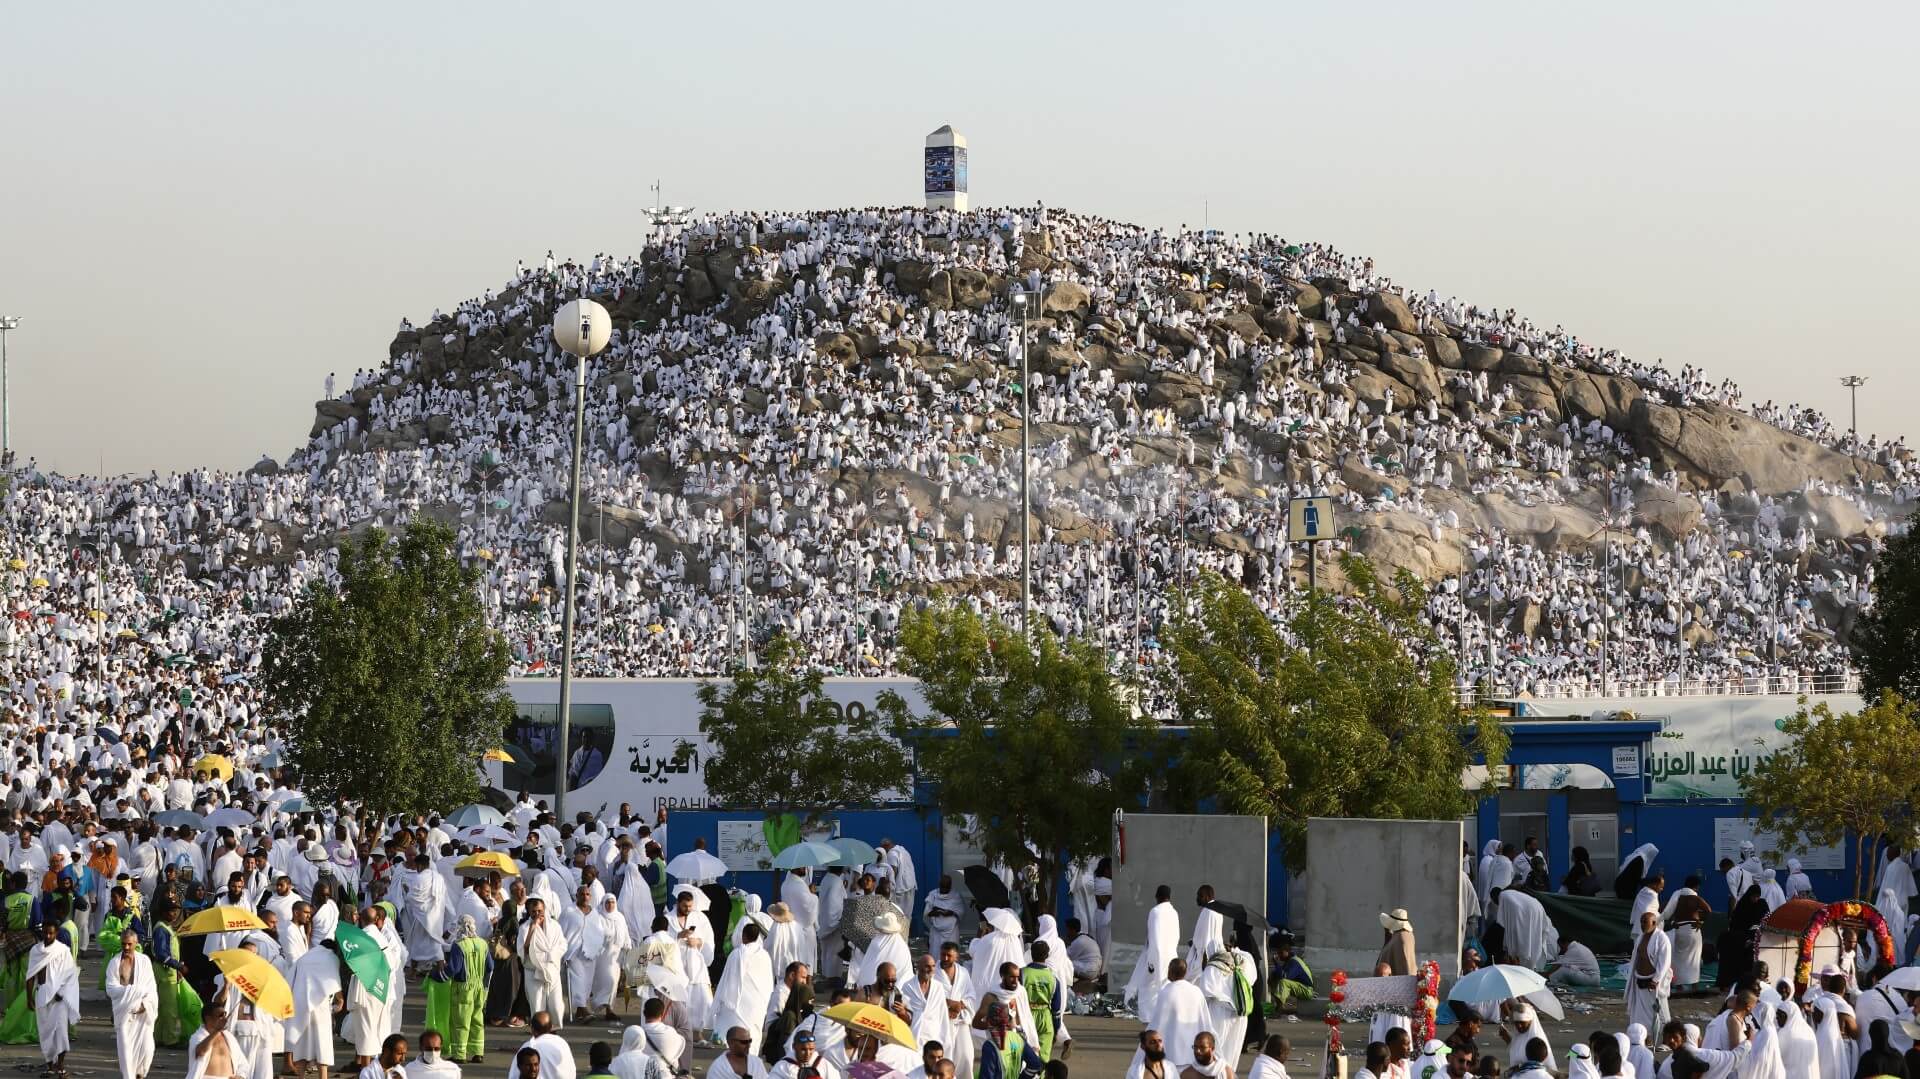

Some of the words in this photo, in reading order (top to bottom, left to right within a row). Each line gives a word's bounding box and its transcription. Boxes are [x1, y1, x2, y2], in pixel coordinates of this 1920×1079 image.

[1699, 755, 1727, 781] عبد
[1592, 831, 1599, 839] 11
[227, 920, 249, 928] DHL
[235, 975, 259, 998] DHL
[859, 1016, 887, 1031] DHL
